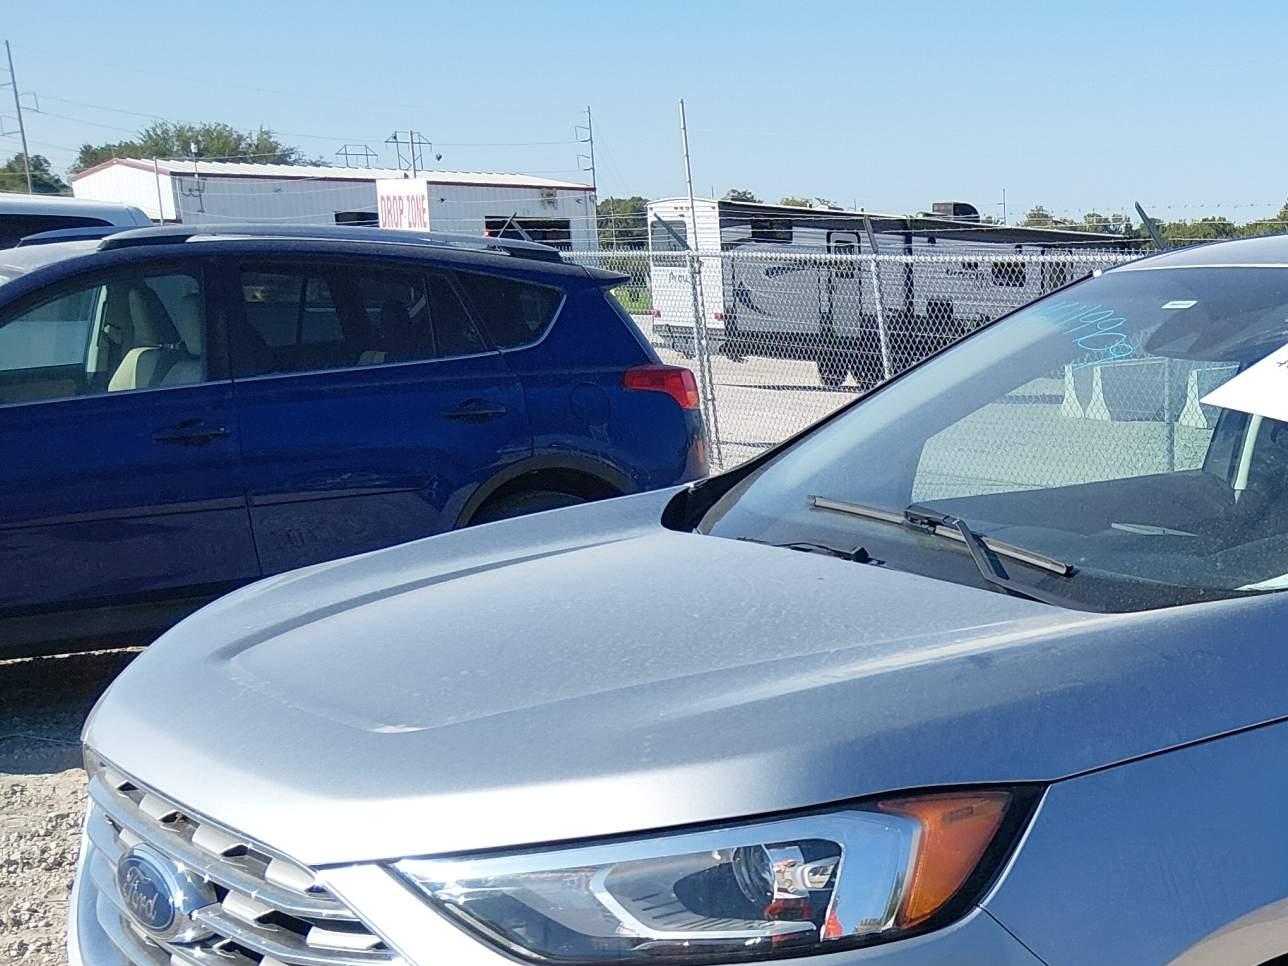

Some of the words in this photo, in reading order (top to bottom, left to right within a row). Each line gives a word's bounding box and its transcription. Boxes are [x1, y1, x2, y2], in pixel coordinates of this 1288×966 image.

[380, 195, 404, 228] DROP
[406, 194, 428, 229] ZONE
[122, 865, 159, 921] Ford
